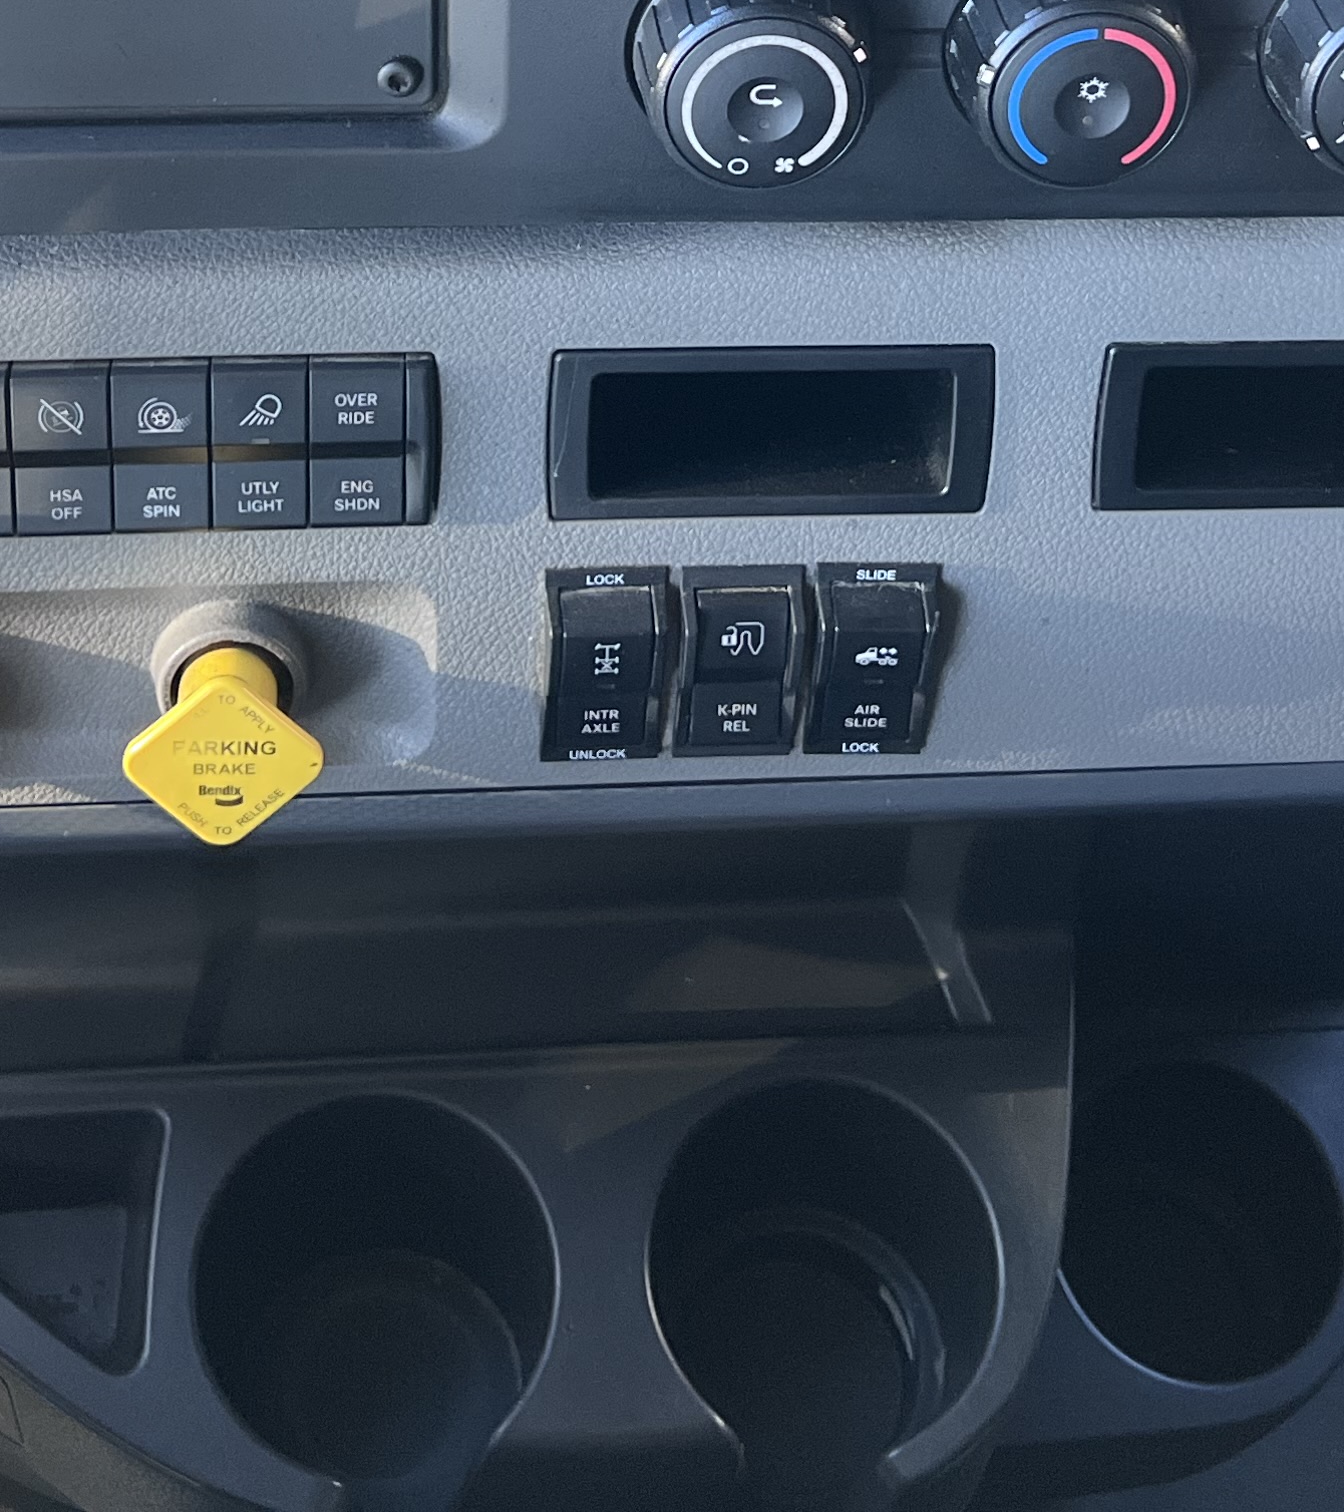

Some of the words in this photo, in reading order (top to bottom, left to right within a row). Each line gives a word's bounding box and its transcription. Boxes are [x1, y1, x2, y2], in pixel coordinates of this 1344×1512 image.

[334, 393, 379, 407] OVER
[337, 410, 376, 425] RIDE
[146, 486, 177, 501] ATC
[241, 481, 280, 496] UTLY
[340, 480, 374, 494] ENG
[49, 489, 84, 503] HSA
[142, 504, 181, 519] SPIN
[237, 498, 285, 514] LIGHT
[334, 497, 381, 512] SHDN
[51, 507, 83, 521] OFF
[585, 573, 625, 586] LOCK
[856, 569, 897, 581] SLIDE
[217, 694, 236, 706] TO
[239, 705, 276, 735] APPLY
[584, 709, 619, 721] INTR
[717, 703, 757, 717] K-PIN
[854, 704, 881, 715] AIR
[581, 722, 620, 734] AXLE
[722, 719, 750, 733] REL
[844, 717, 887, 728] SLIDE
[568, 748, 627, 761] UNLOCK
[841, 742, 880, 753] LOCK
[193, 762, 256, 776] BRAKE
[198, 785, 242, 796] Bendix
[177, 802, 209, 828] PUSH
[214, 826, 232, 836] TO
[236, 788, 285, 827] RELEASE
